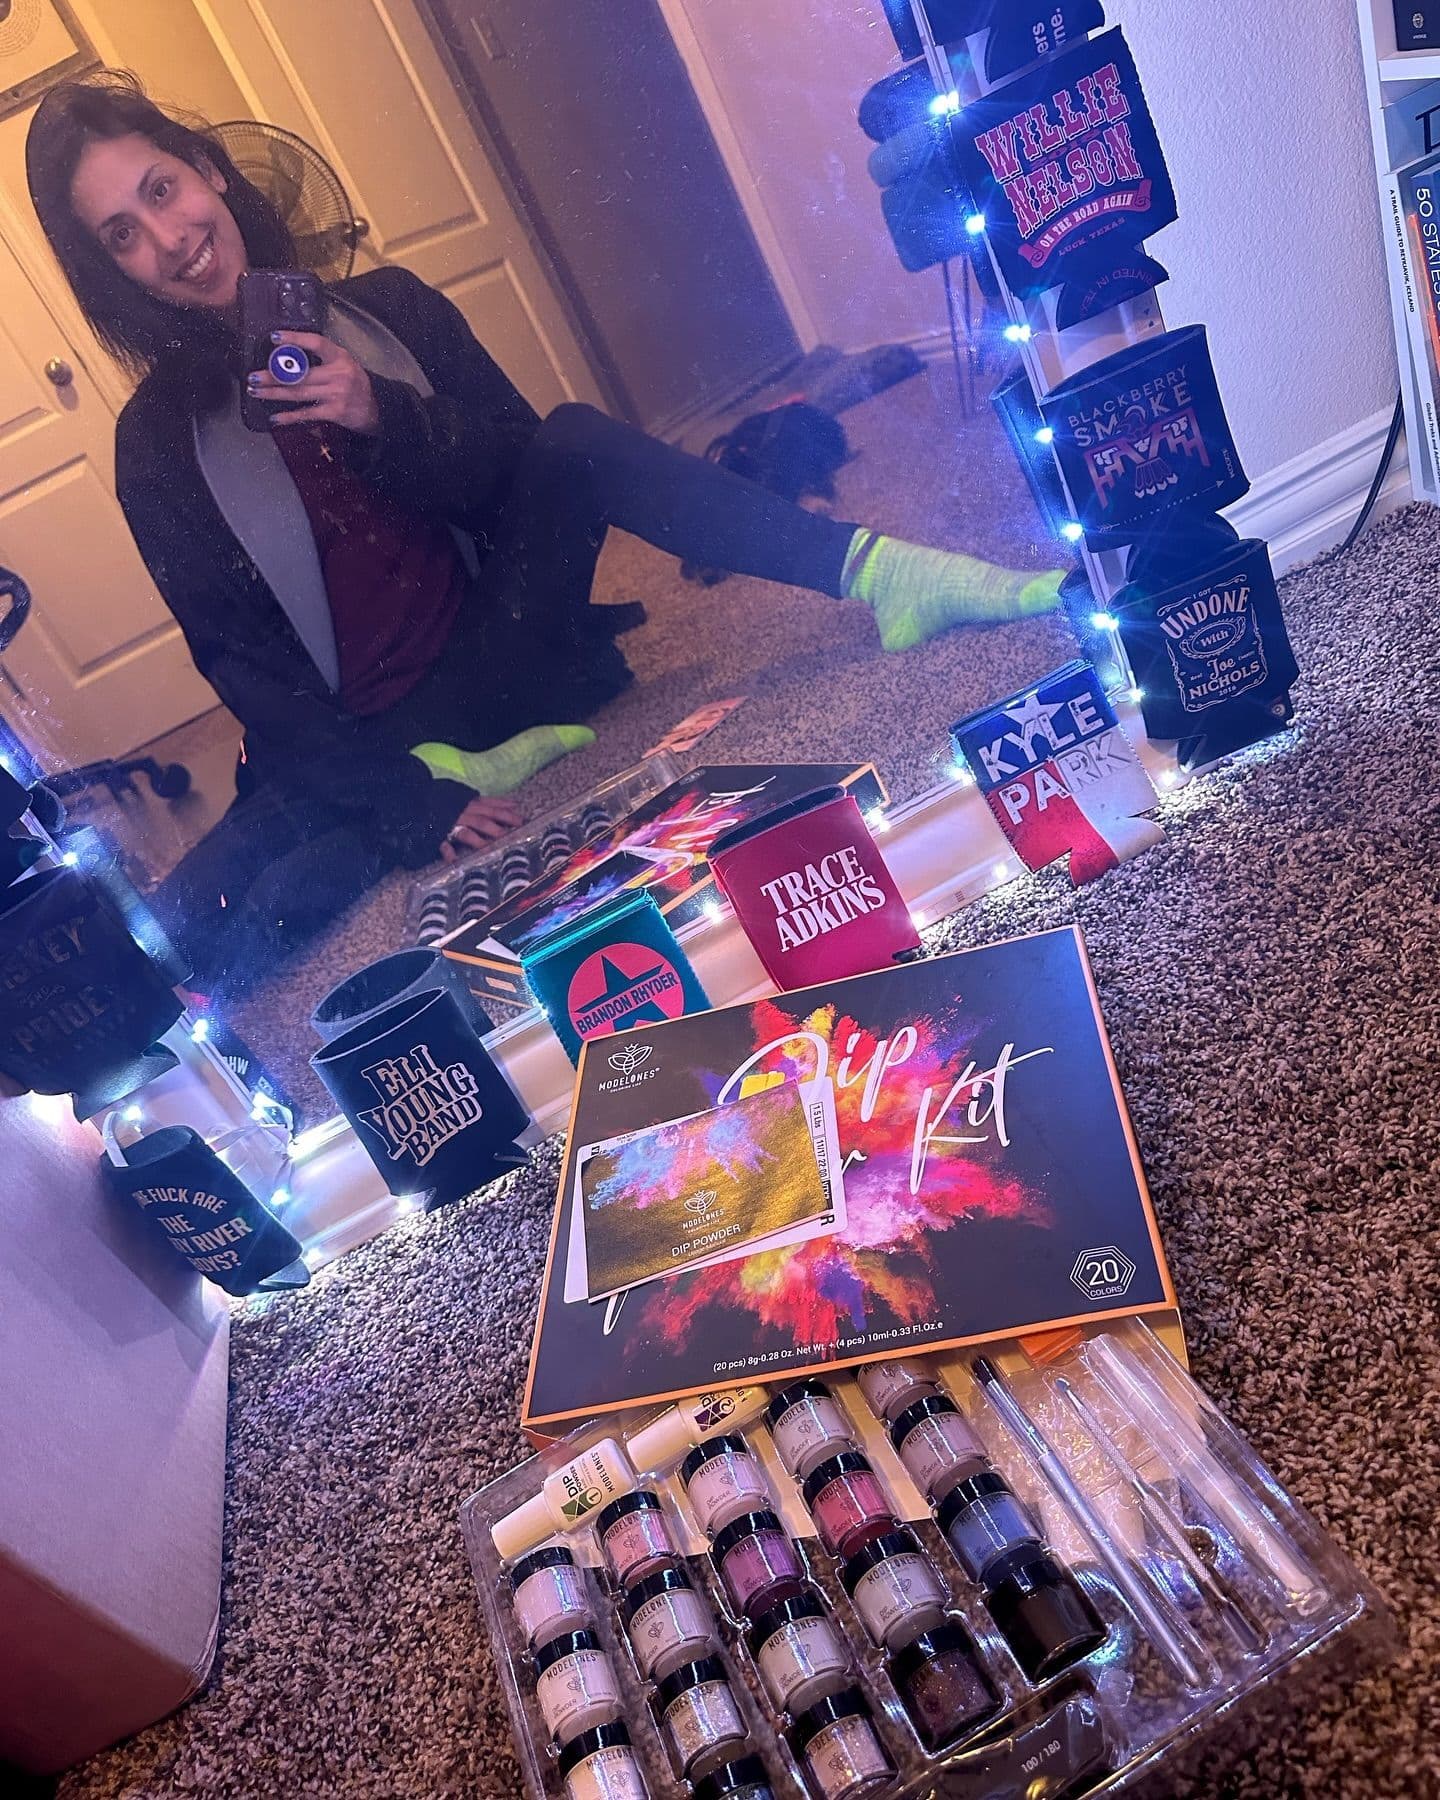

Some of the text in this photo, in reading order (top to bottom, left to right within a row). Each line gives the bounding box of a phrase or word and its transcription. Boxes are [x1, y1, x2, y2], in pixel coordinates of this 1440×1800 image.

[974, 63, 1131, 183] WILLIE
[1003, 121, 1143, 239] NELSON
[1039, 193, 1133, 248] ON THE ROAD AGAIN
[1416, 188, 1433, 217] 50
[1058, 217, 1126, 257] LUCK TEXAS
[1394, 215, 1402, 236] GUIDE
[1406, 285, 1415, 313] ICELAND
[1068, 365, 1187, 428] BLACKBERRY
[1160, 587, 1250, 639] UNDONE
[1200, 629, 1229, 647] With
[1189, 660, 1261, 700] NICHOLS
[1207, 658, 1237, 680] Joe
[978, 692, 1105, 783] KYLE
[999, 731, 1132, 825] PARK
[760, 846, 866, 915] TRACE
[775, 875, 886, 953] ADKINS
[576, 972, 678, 1034] BRANDON RHYDER
[360, 1044, 442, 1107] ELI
[599, 1069, 656, 1091] MODELONES
[356, 1062, 480, 1160] YOUNG
[404, 1095, 482, 1166] BAND
[910, 1043, 1054, 1195] Kit
[148, 1187, 189, 1204] FUCK
[192, 1191, 227, 1214] ARE
[157, 1214, 196, 1234] THE
[191, 1217, 253, 1252] RIVER
[671, 1242, 690, 1257] DIP
[692, 1224, 741, 1249] POWDER
[1086, 1259, 1119, 1286] 20
[1090, 1285, 1123, 1297] COLORS
[713, 1361, 727, 1372] (20
[728, 1357, 746, 1371] pcs)
[747, 1351, 779, 1367] 8g-0.28
[780, 1348, 795, 1359] Oz.
[796, 1345, 812, 1356] Net
[835, 1338, 846, 1350] (4
[846, 1334, 866, 1348] pcs)
[867, 1327, 911, 1342] 10ml-0.33
[562, 1475, 579, 1498] DIP
[568, 1464, 584, 1493] POWDER
[590, 1452, 615, 1493] MODELONES
[546, 1652, 598, 1681] MODELNES
[1021, 1756, 1039, 1773] 100
[1043, 1740, 1061, 1757] 180
